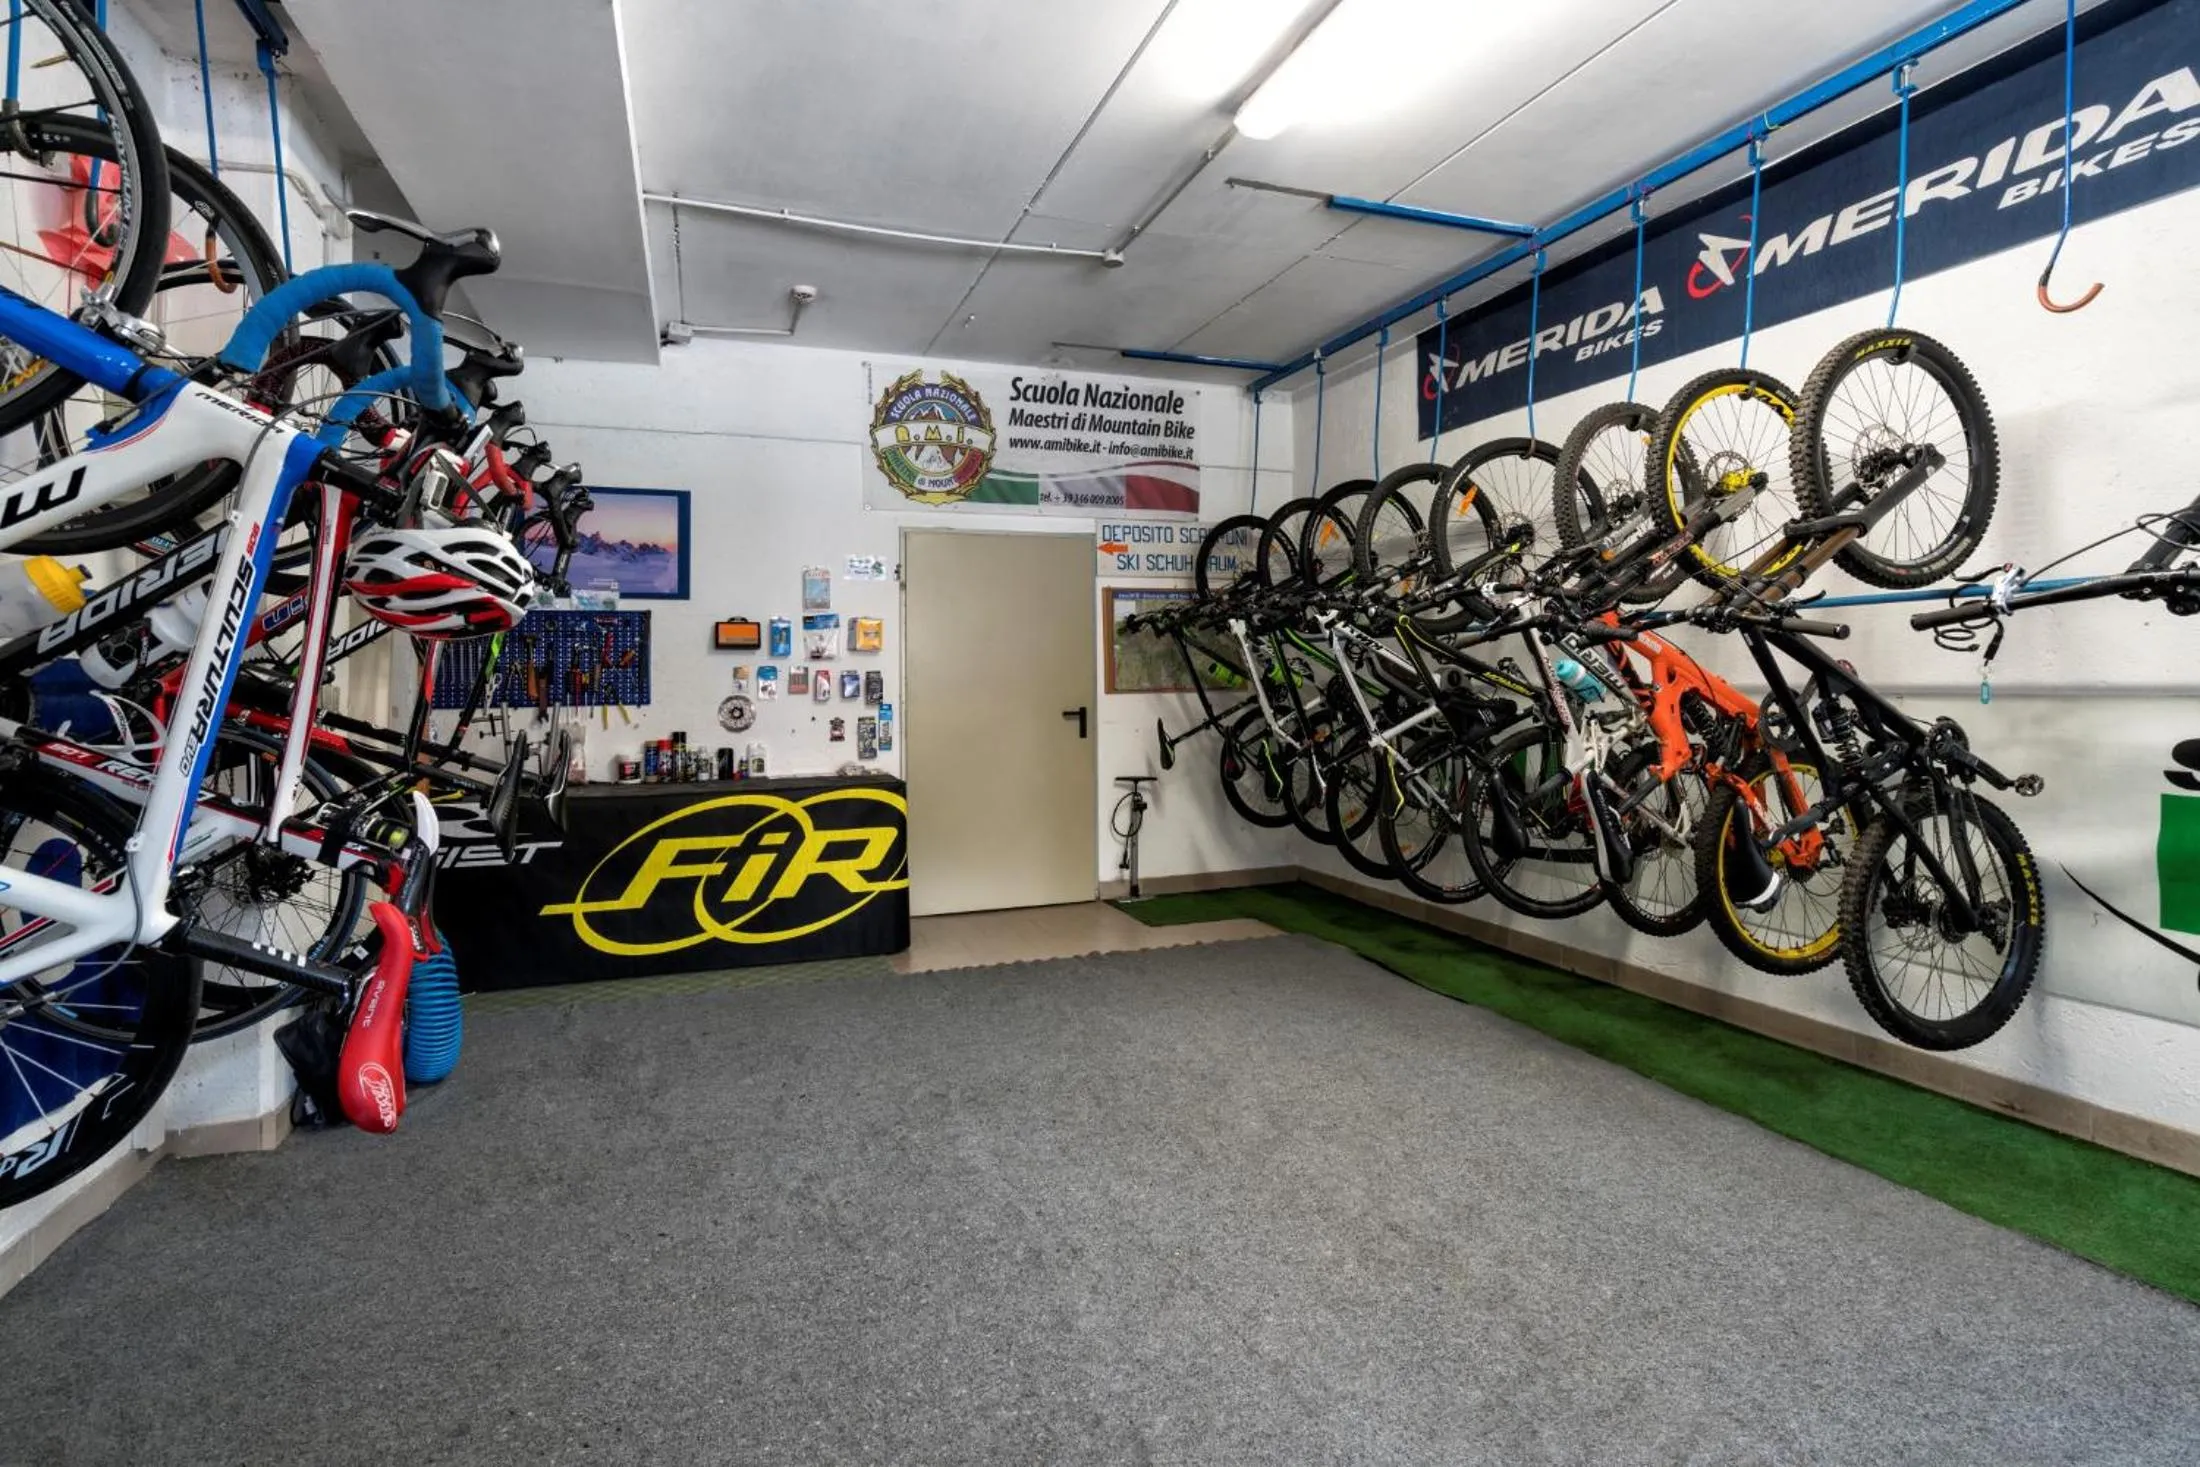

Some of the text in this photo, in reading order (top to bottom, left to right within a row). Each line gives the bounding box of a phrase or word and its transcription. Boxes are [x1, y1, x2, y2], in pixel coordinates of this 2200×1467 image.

[1753, 66, 2200, 277] MERIDA
[1998, 117, 2200, 210] BIKES
[1455, 286, 1665, 390] MERIDA
[1575, 319, 1664, 363] BIKES
[1009, 376, 1185, 414] Scuola Nazionale
[1008, 408, 1195, 440] Maestri di Mountain Bike
[1009, 436, 1100, 454] www.amibike.it
[1108, 441, 1194, 460] info@amibike.it
[1102, 525, 1173, 544] DEPOSITO
[1117, 554, 1140, 571] SKI
[1146, 554, 1193, 571] SCHUH
[193, 554, 254, 746] SCULTURA
[2016, 853, 2039, 926] MAXXIS
